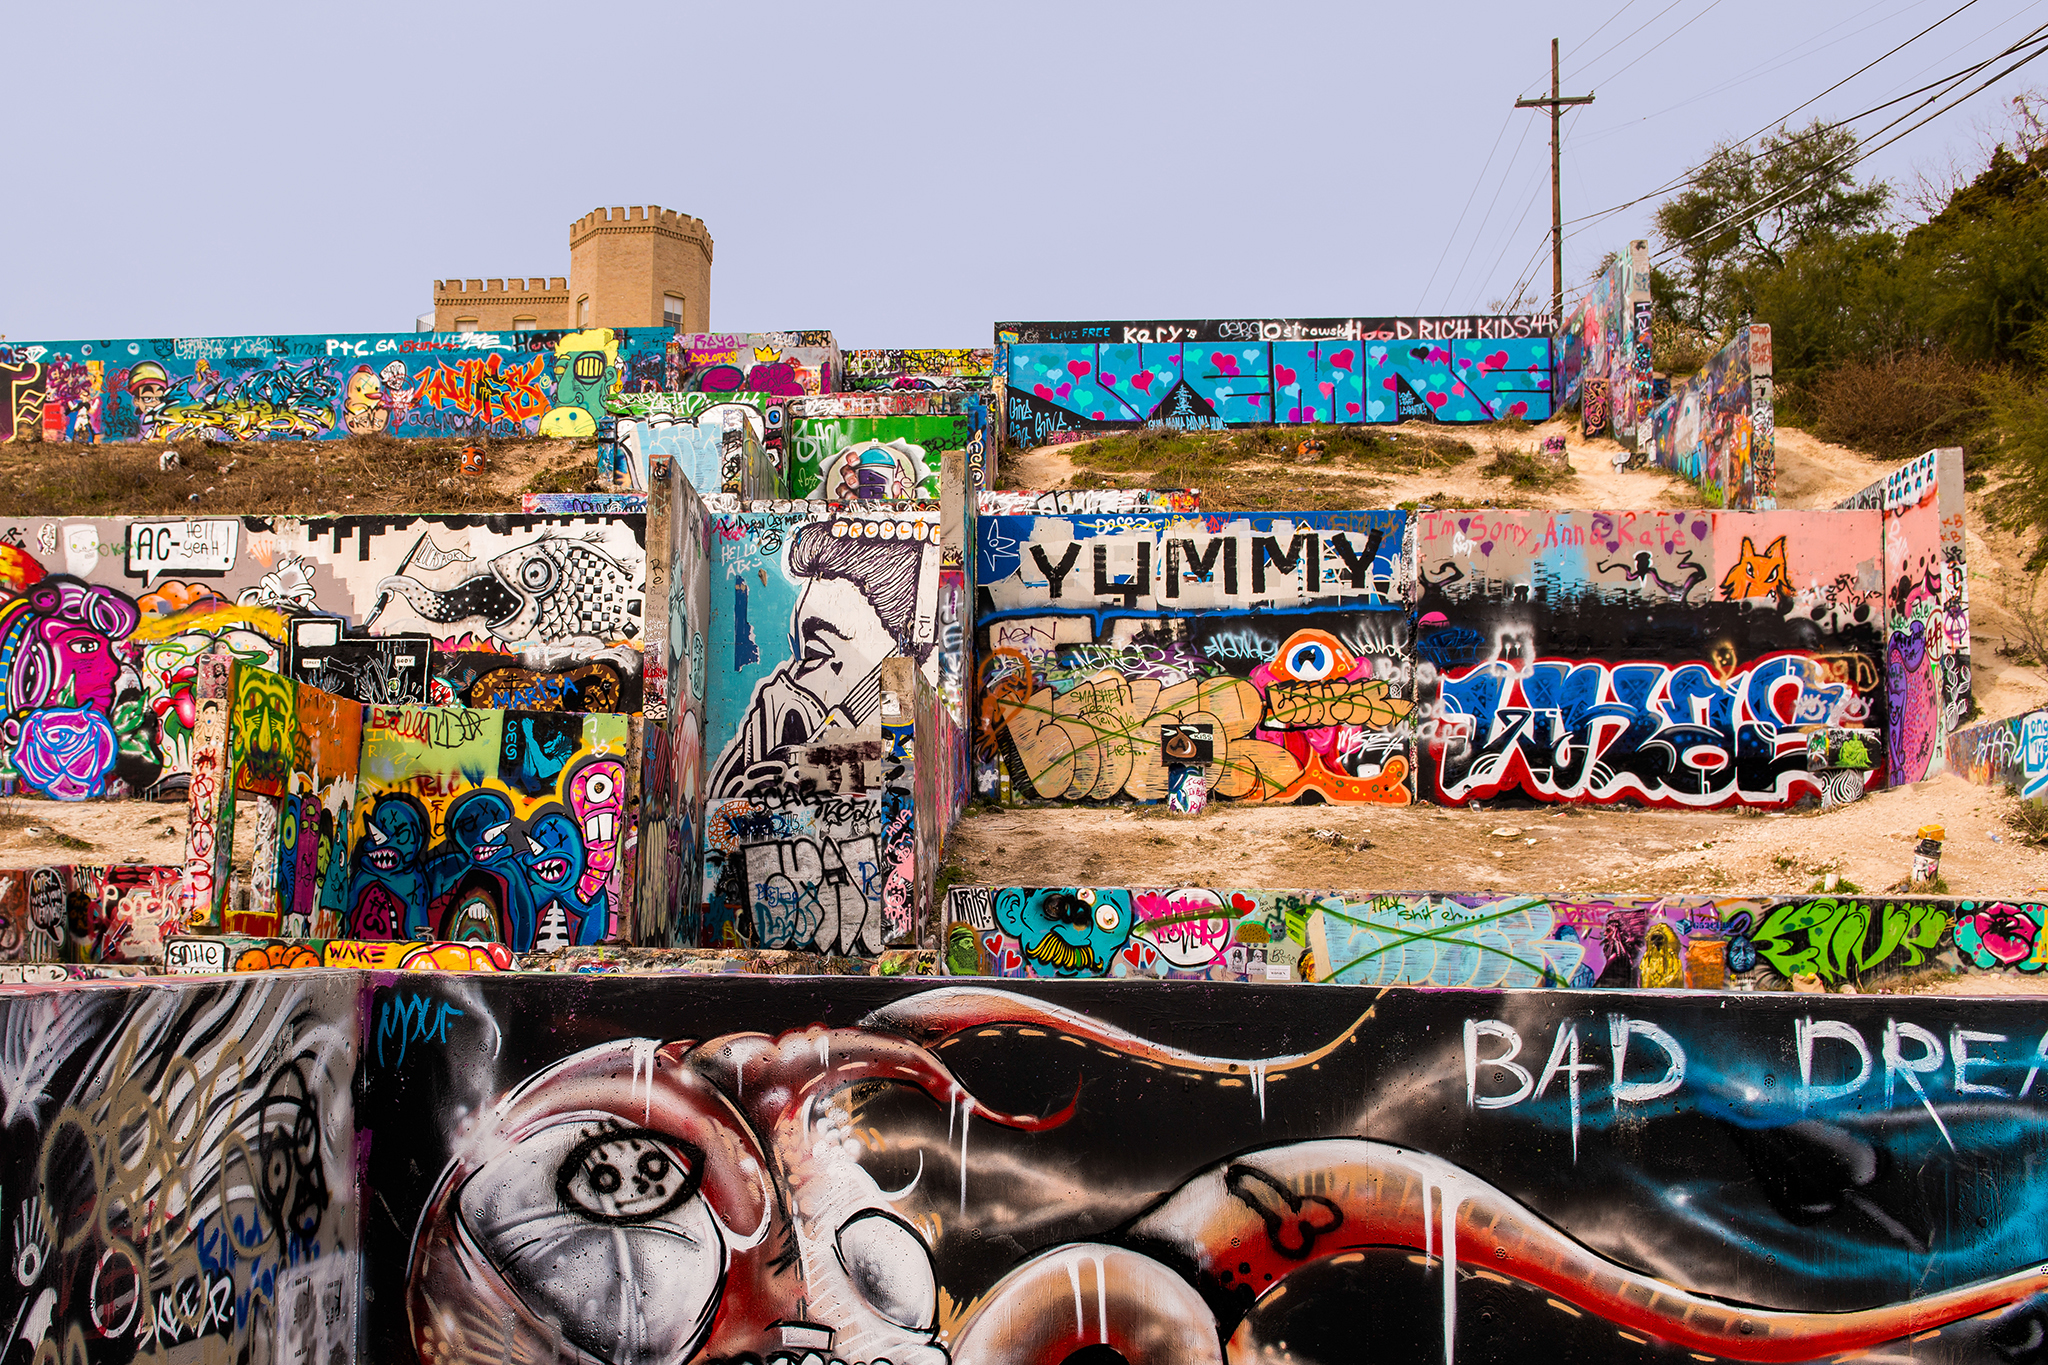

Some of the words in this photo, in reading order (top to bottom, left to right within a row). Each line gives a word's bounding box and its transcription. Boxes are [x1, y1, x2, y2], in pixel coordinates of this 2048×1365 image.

[1082, 327, 1110, 338] FREE
[1419, 319, 1472, 339] RICH
[1477, 317, 1531, 339] KIDS
[1423, 510, 1456, 541] I'm
[1618, 514, 1686, 547] Kate
[721, 543, 757, 566] HELLO
[329, 942, 388, 965] WAKE
[1464, 1012, 1687, 1115] BAD
